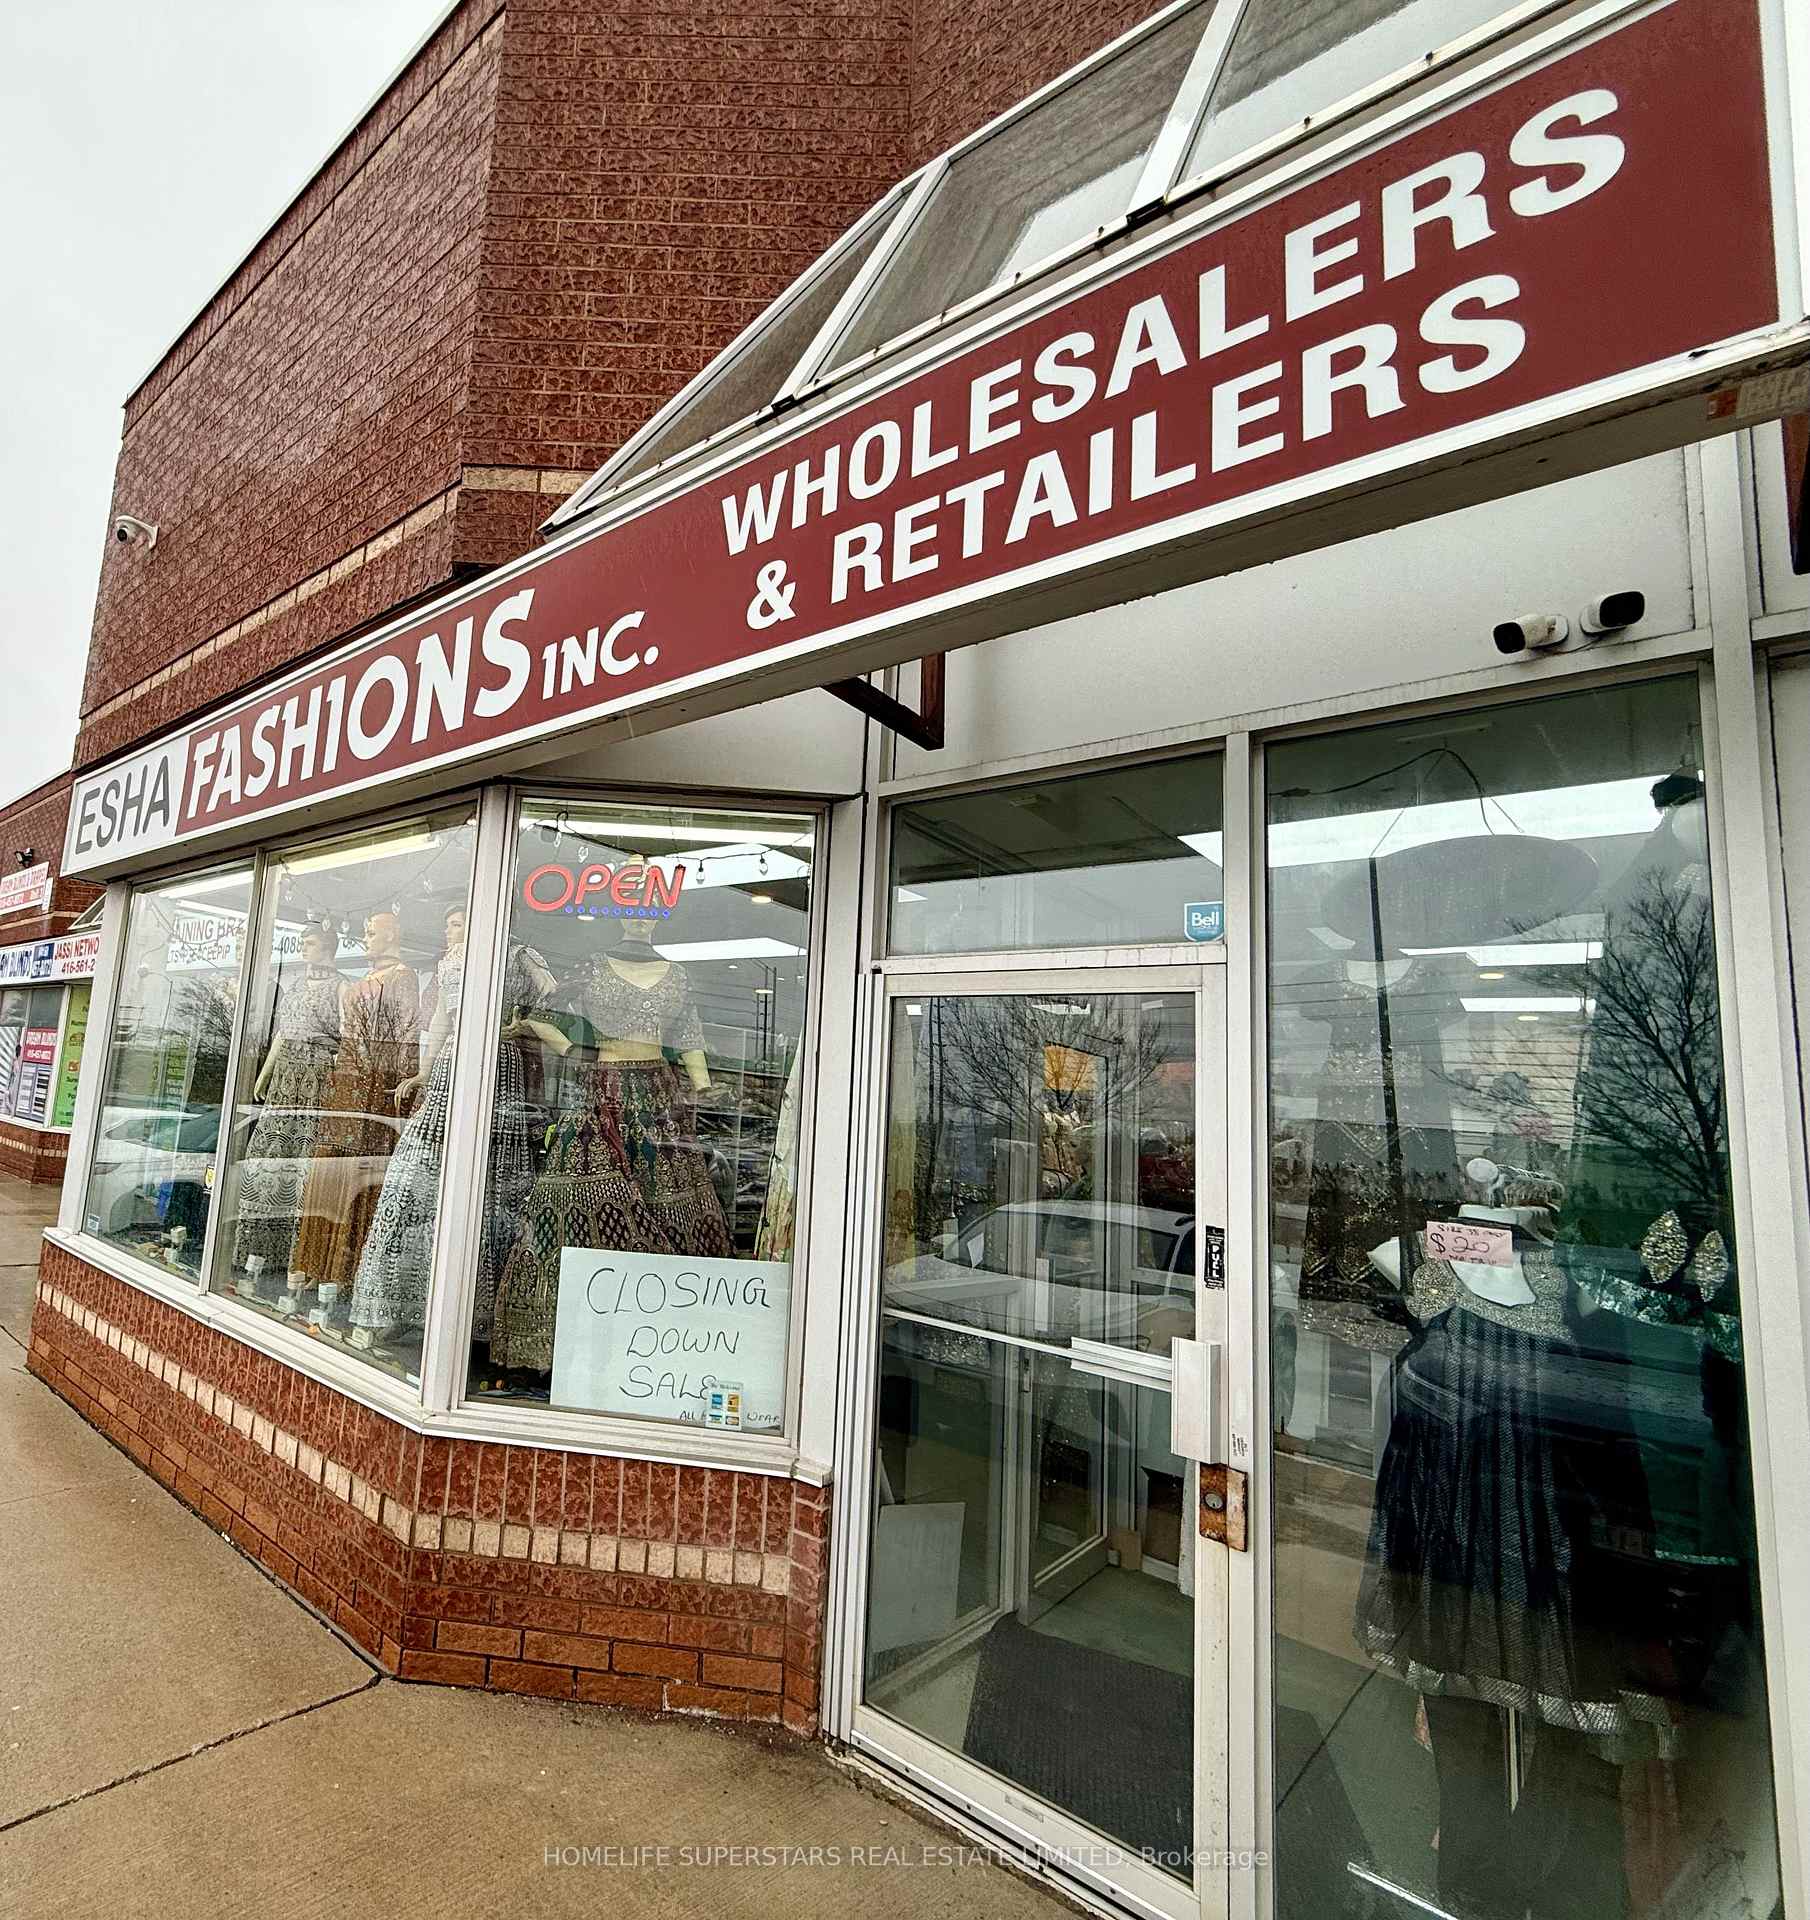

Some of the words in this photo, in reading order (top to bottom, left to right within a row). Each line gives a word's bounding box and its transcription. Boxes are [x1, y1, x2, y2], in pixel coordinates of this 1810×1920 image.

[721, 88, 1625, 556] WHOLESALERS
[745, 559, 797, 631] &
[831, 274, 1526, 604] RETAILERS
[75, 755, 171, 855] ESHA
[186, 588, 536, 819] FASHIONS
[541, 611, 660, 700] INC.
[523, 864, 687, 912] OPEN
[1191, 911, 1220, 927] Bell
[54, 941, 74, 961] JASSI
[586, 1267, 771, 1315] CLOSING
[627, 1325, 740, 1358] DOWN
[618, 1365, 718, 1400] SALE
